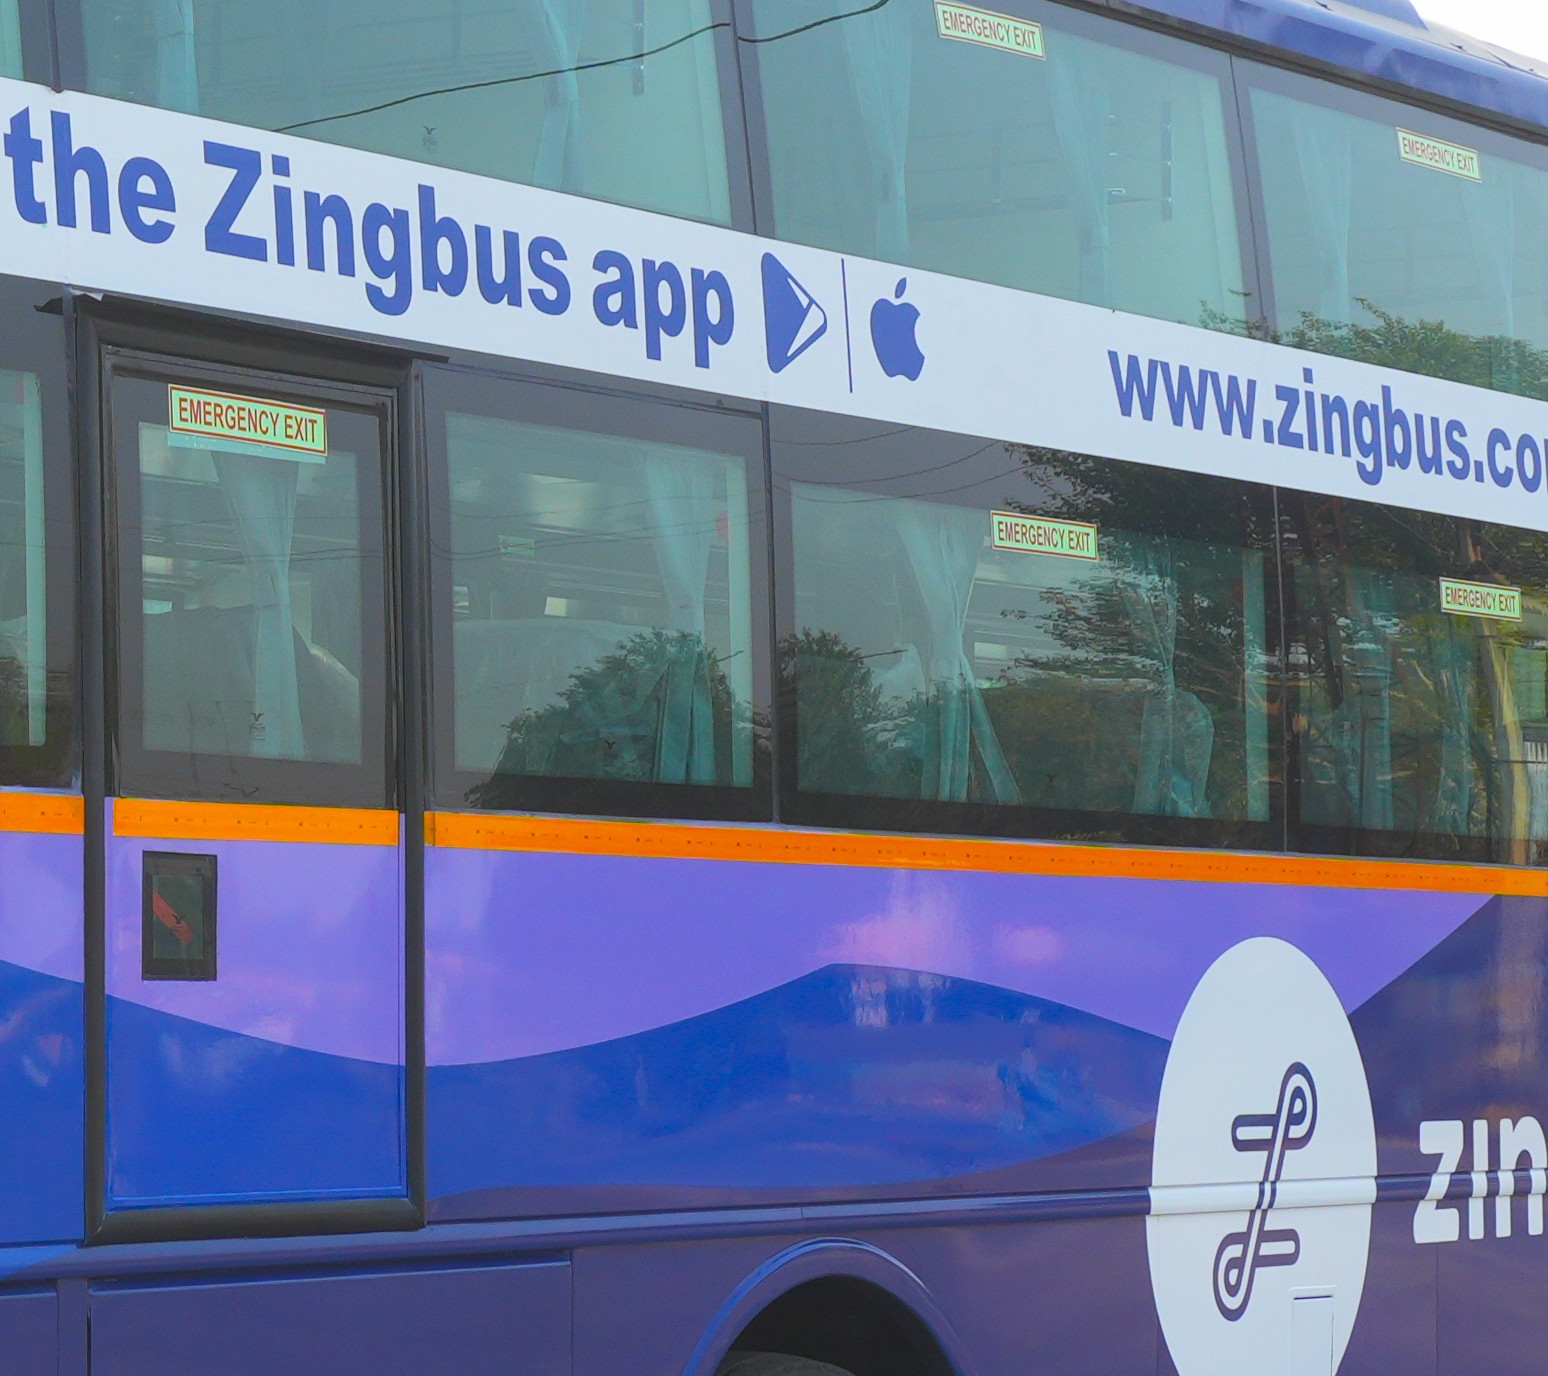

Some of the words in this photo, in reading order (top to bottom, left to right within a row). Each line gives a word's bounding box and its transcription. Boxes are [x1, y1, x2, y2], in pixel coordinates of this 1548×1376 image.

[942, 10, 1010, 43] EMERGENCY
[1013, 26, 1036, 51] EXIT
[1402, 137, 1454, 168] EMERGENCY
[1456, 153, 1475, 173] EXIT
[4, 106, 176, 244] the
[203, 140, 572, 317] Zingbus
[592, 249, 734, 369] app
[179, 397, 279, 436] EMERGENCY
[284, 415, 317, 443] EXIT
[998, 521, 1065, 548] EMERGENCY
[1068, 530, 1091, 552] EXIT
[1445, 586, 1496, 611] EMERGENCY
[1499, 594, 1516, 613] EXIT
